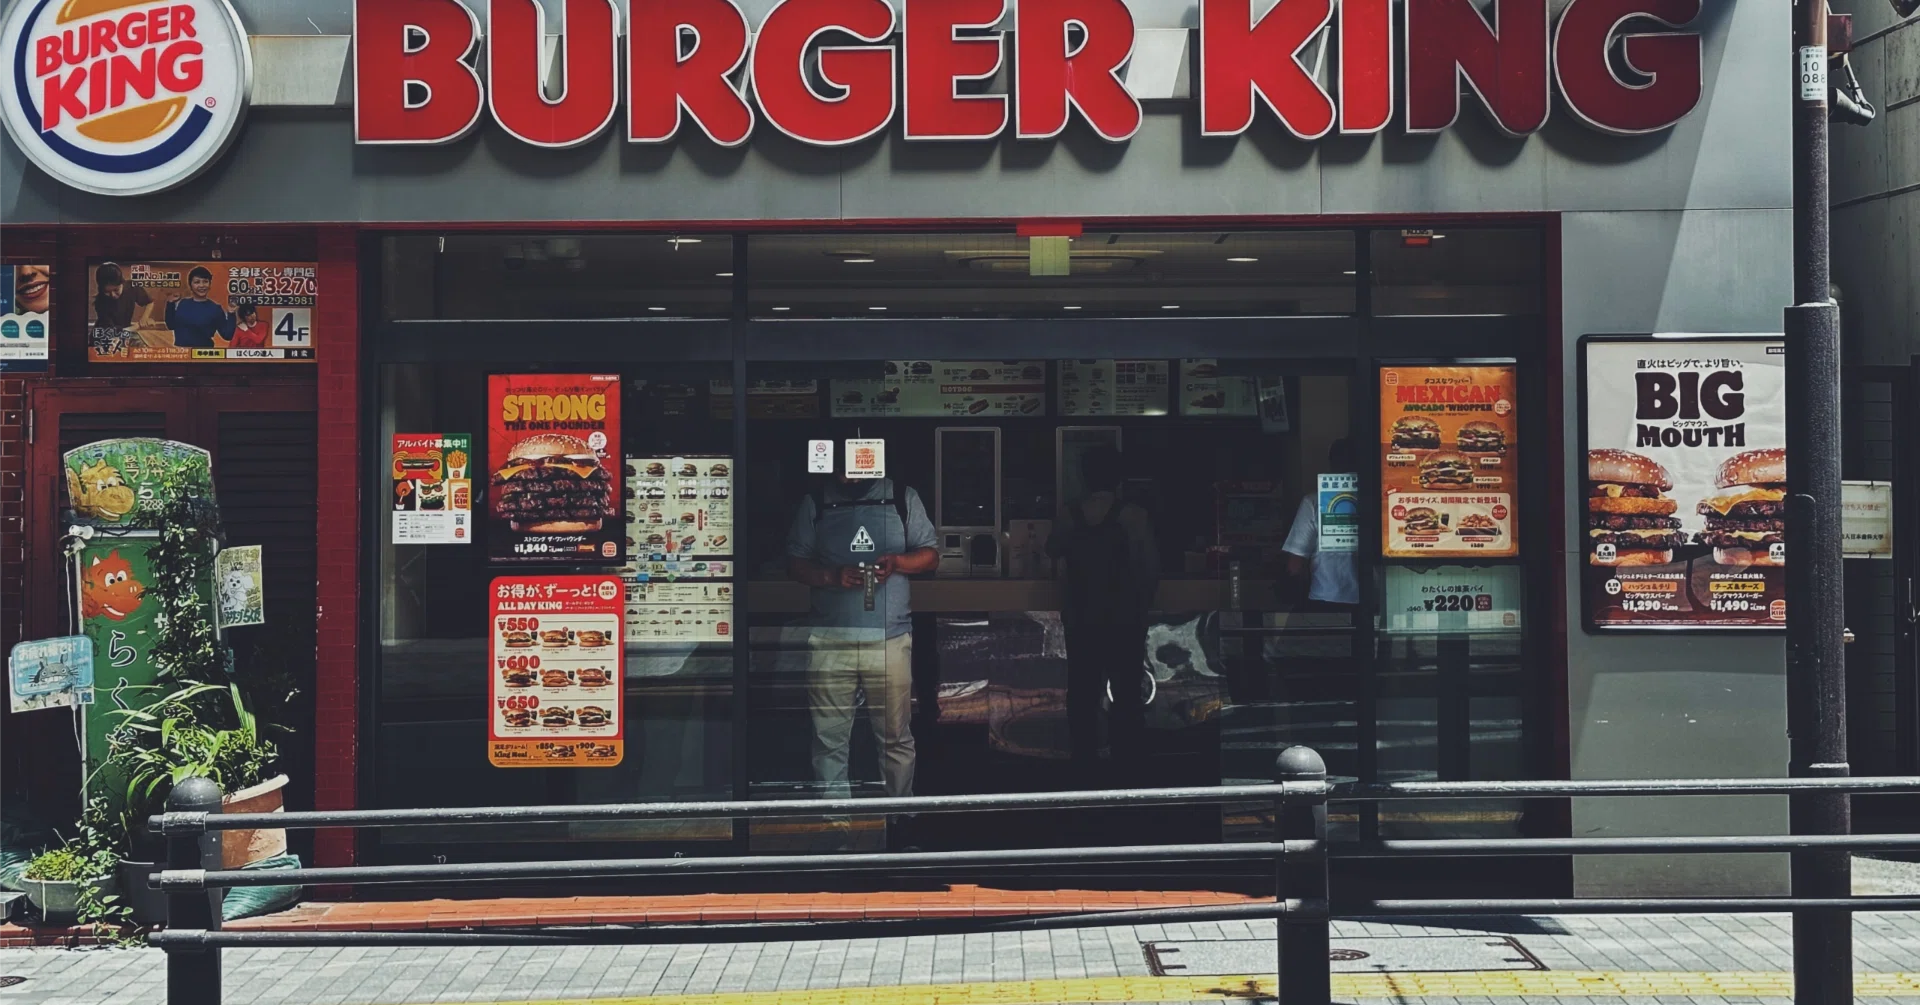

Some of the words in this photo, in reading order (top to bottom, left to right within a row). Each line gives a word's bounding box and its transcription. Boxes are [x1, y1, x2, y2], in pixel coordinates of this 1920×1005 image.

[36, 4, 197, 77] BURGER
[355, 0, 1143, 147] BURGER
[1200, 0, 1704, 137] KING
[43, 40, 204, 131] KING
[228, 267, 315, 277] 全身ほぐし専門店
[238, 296, 314, 305] 03-5212-2981
[274, 312, 310, 342] 4F
[235, 349, 275, 358] ほぐしの達人
[1636, 358, 1744, 369] 直火はビッグで、より旨い。
[1395, 385, 1501, 404] MEXICAN
[1635, 370, 1745, 421] BIG
[502, 393, 606, 421] STRONG
[1403, 404, 1445, 412] AVOCADO
[504, 421, 527, 432] THE
[528, 421, 551, 431] ONE
[553, 421, 605, 431] POUNDER
[1672, 420, 1709, 428] ビッグマウス
[1636, 422, 1746, 448] MOUTH
[497, 583, 598, 599] お得が、ずーっと!
[498, 602, 516, 611] ALL
[517, 602, 537, 611] DAY
[538, 601, 563, 611] KING
[1423, 594, 1474, 612] ¥220
[497, 617, 540, 631] ¥550
[497, 655, 541, 669] ¥600
[497, 695, 540, 709] ¥650
